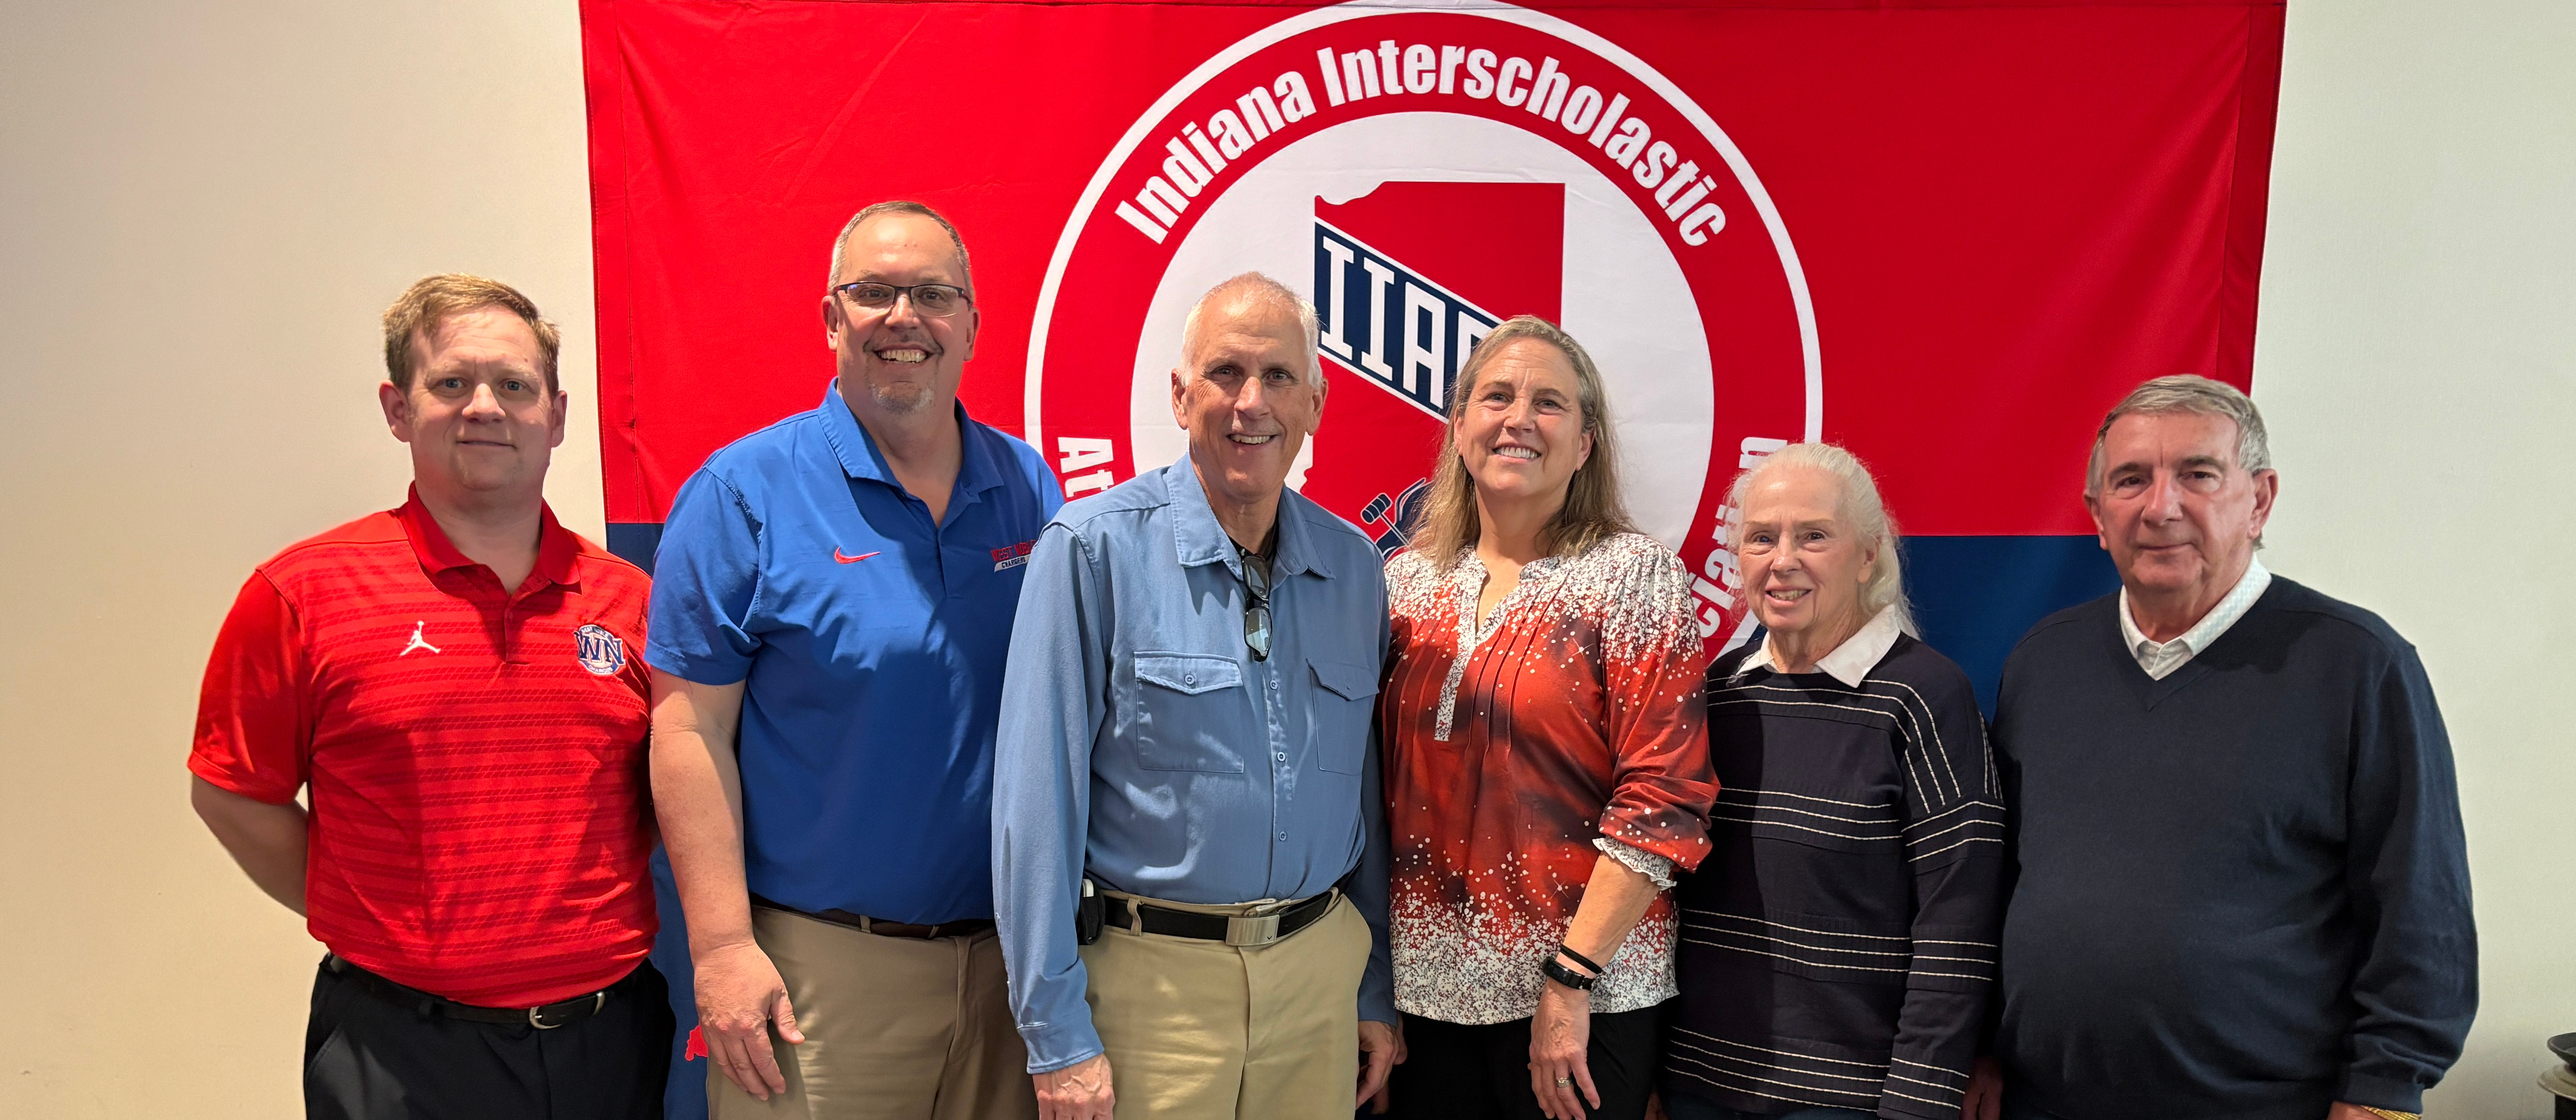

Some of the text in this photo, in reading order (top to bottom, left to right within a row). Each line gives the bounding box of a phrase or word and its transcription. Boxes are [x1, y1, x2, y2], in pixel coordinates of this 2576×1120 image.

[1115, 40, 1726, 246] Indiana Interscholastic
[574, 631, 624, 664] WN
